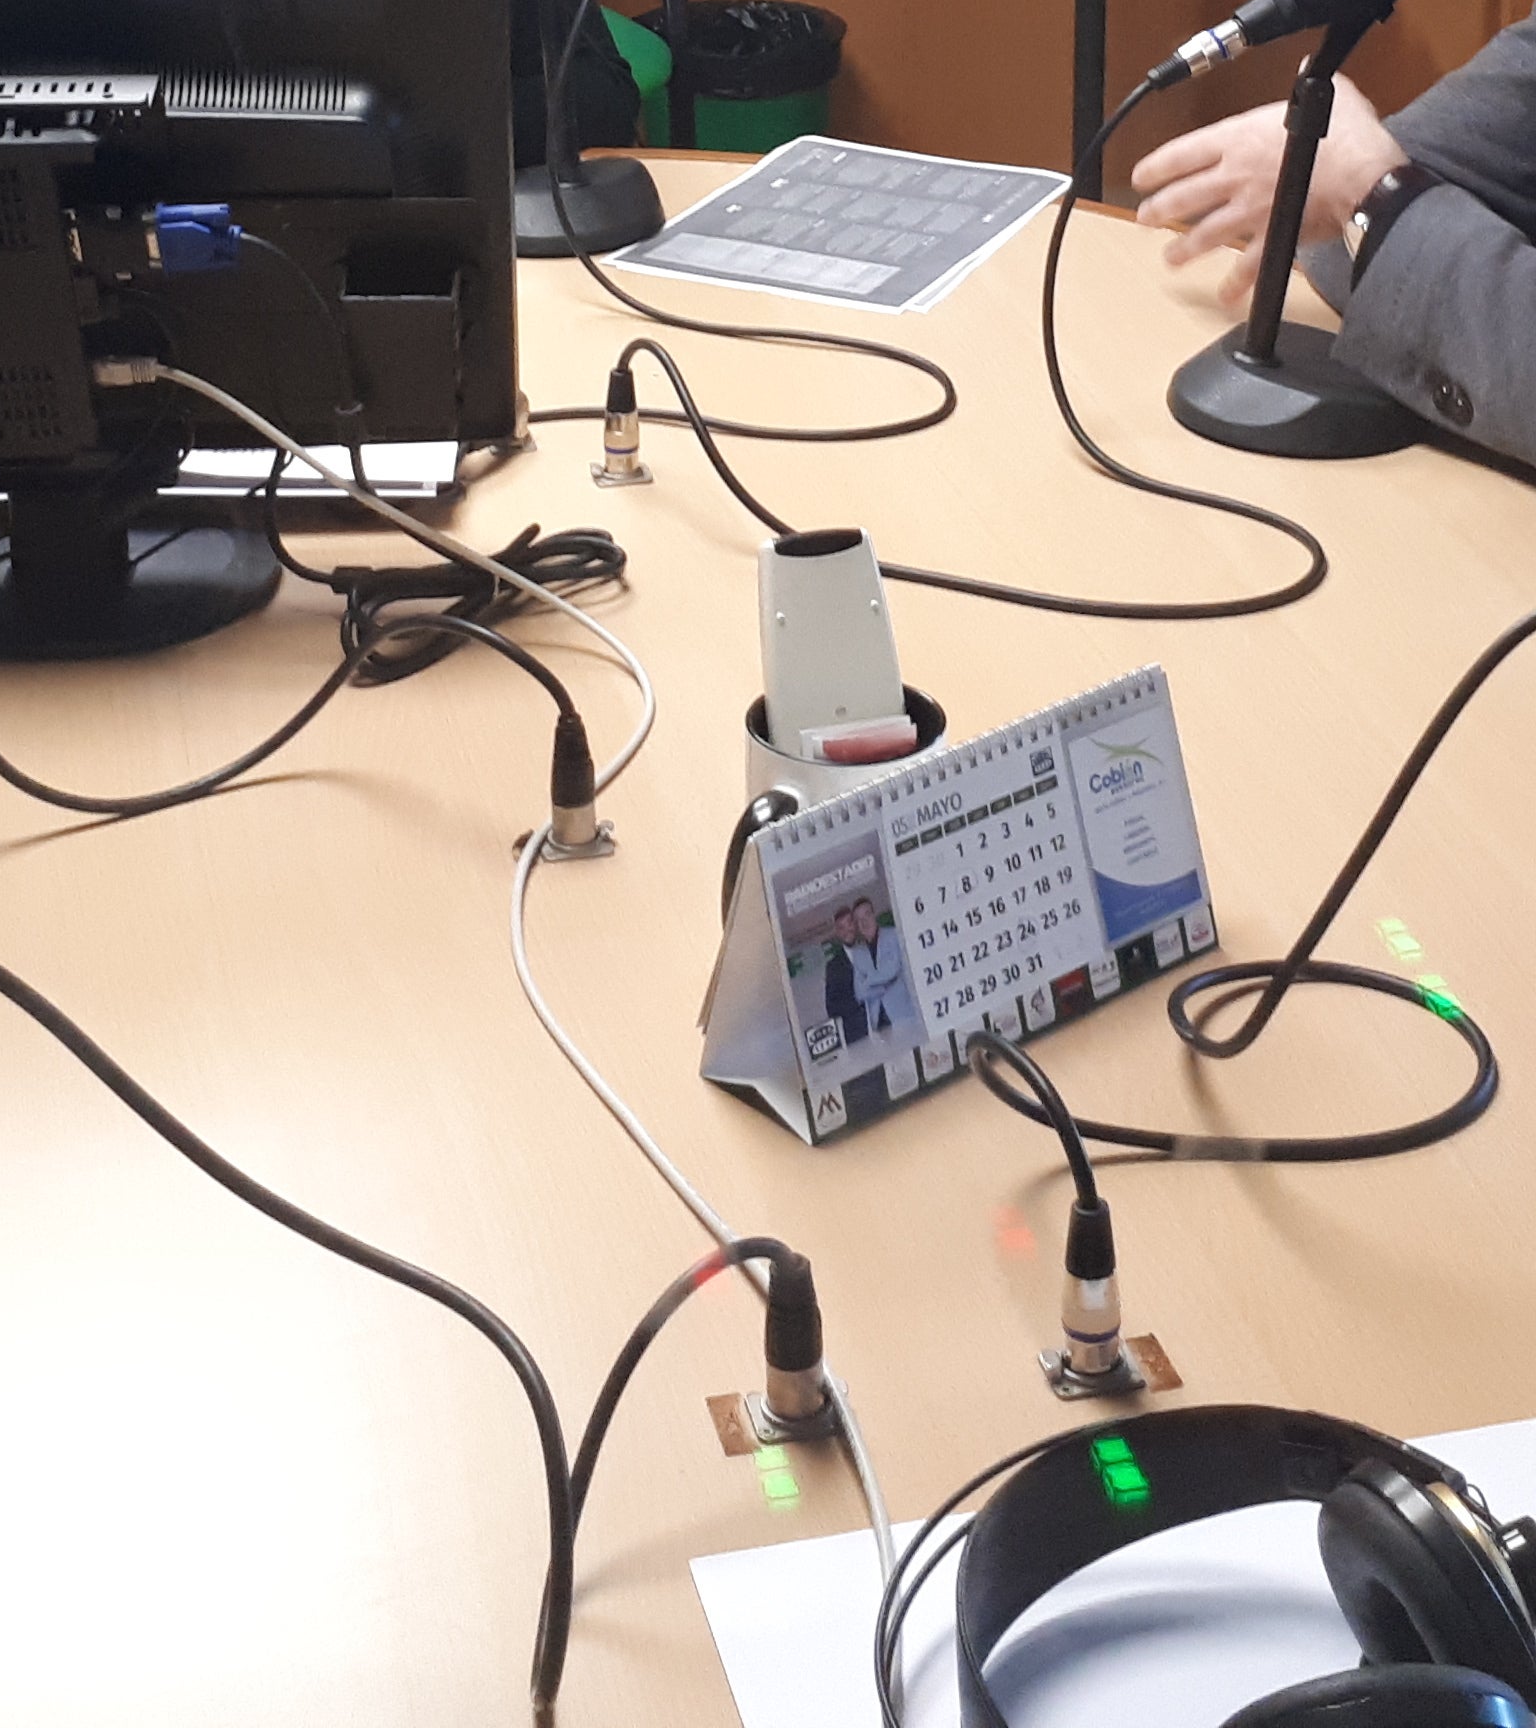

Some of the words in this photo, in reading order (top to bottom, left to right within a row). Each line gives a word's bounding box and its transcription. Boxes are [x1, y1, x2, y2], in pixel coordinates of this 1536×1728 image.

[917, 792, 962, 825] MAYO
[956, 843, 964, 858] 1
[979, 832, 988, 849] 2
[1001, 822, 1011, 839] 3
[1025, 812, 1034, 828] 4
[1046, 802, 1056, 819] 5
[915, 896, 924, 915] 6
[938, 886, 946, 905] 7
[961, 876, 971, 894] 8
[984, 865, 994, 883] 9
[1003, 853, 1021, 872] 10
[1028, 844, 1044, 862] 11
[1050, 834, 1066, 852] 12
[918, 929, 935, 949] 13
[942, 919, 958, 939] 14
[965, 908, 983, 927] 15
[988, 897, 1006, 917] 16
[1012, 886, 1027, 905] 17
[1034, 876, 1051, 896] 18
[1057, 866, 1073, 885] 19
[923, 963, 942, 986] 20
[948, 952, 965, 973] 21
[971, 941, 989, 962] 22
[995, 930, 1013, 952] 23
[1018, 921, 1036, 941] 24
[1041, 908, 1058, 930] 25
[1063, 898, 1081, 919] 26
[933, 997, 949, 1018] 27
[955, 986, 975, 1007] 28
[979, 974, 997, 996] 29
[1001, 964, 1021, 985] 30
[1026, 952, 1043, 973] 31
